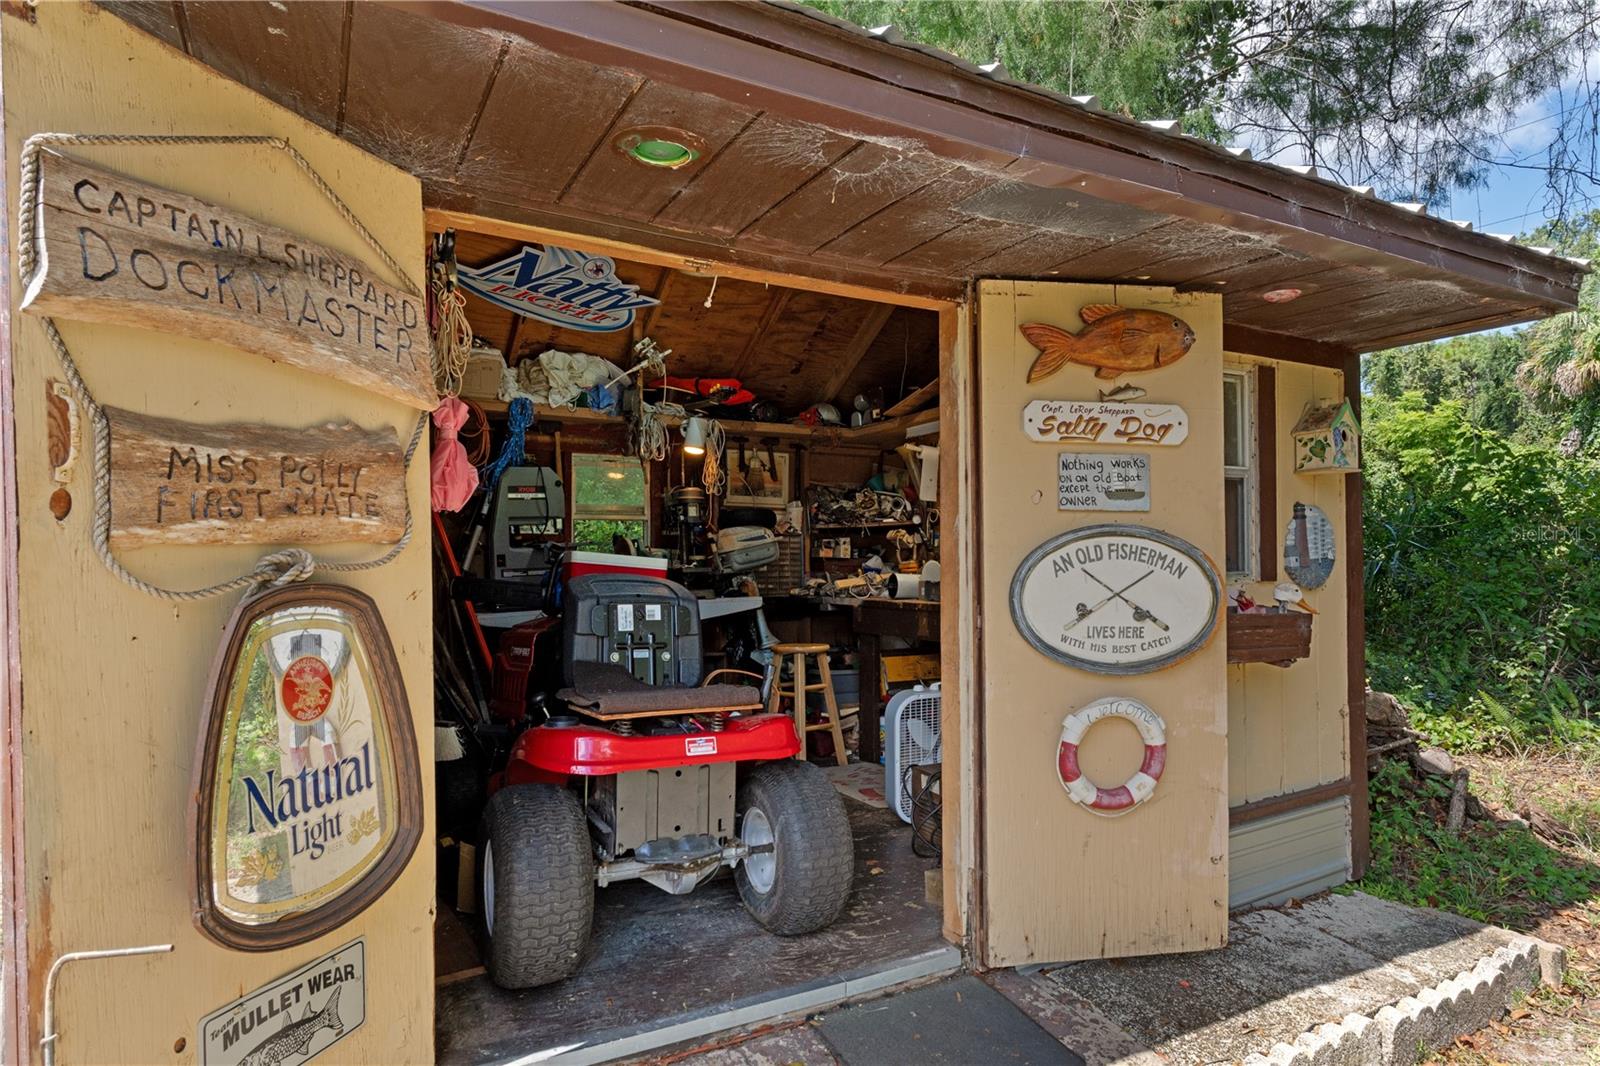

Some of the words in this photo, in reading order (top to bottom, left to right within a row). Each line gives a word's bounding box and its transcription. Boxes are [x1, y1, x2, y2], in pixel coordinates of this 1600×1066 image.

[74, 179, 243, 250] CAPTAIN
[284, 242, 418, 330] SHEPPARD
[457, 250, 653, 312] Natty
[1037, 414, 1108, 442] Salty
[1114, 416, 1173, 443] Dog
[167, 447, 257, 485] MISS
[1093, 473, 1112, 483] old
[1117, 472, 1142, 482] Boat
[157, 485, 271, 523] FIRST
[293, 487, 380, 518] MATE
[1059, 484, 1091, 494] except
[1096, 484, 1112, 493] the
[1052, 555, 1075, 578] AN
[1075, 544, 1104, 564] OLD
[1107, 543, 1188, 579] FISHERMAN
[1060, 633, 1085, 649] WITH
[1090, 643, 1107, 653] HIS
[1112, 644, 1136, 653] BEST
[1141, 635, 1172, 651] CATCH
[1087, 626, 1115, 639] LIVES
[1118, 626, 1145, 639] HERE
[242, 742, 375, 834] Natural
[291, 811, 343, 860] Light
[210, 1016, 235, 1042] Team
[223, 982, 304, 1051] MULLET
[308, 963, 355, 996] WEAR
